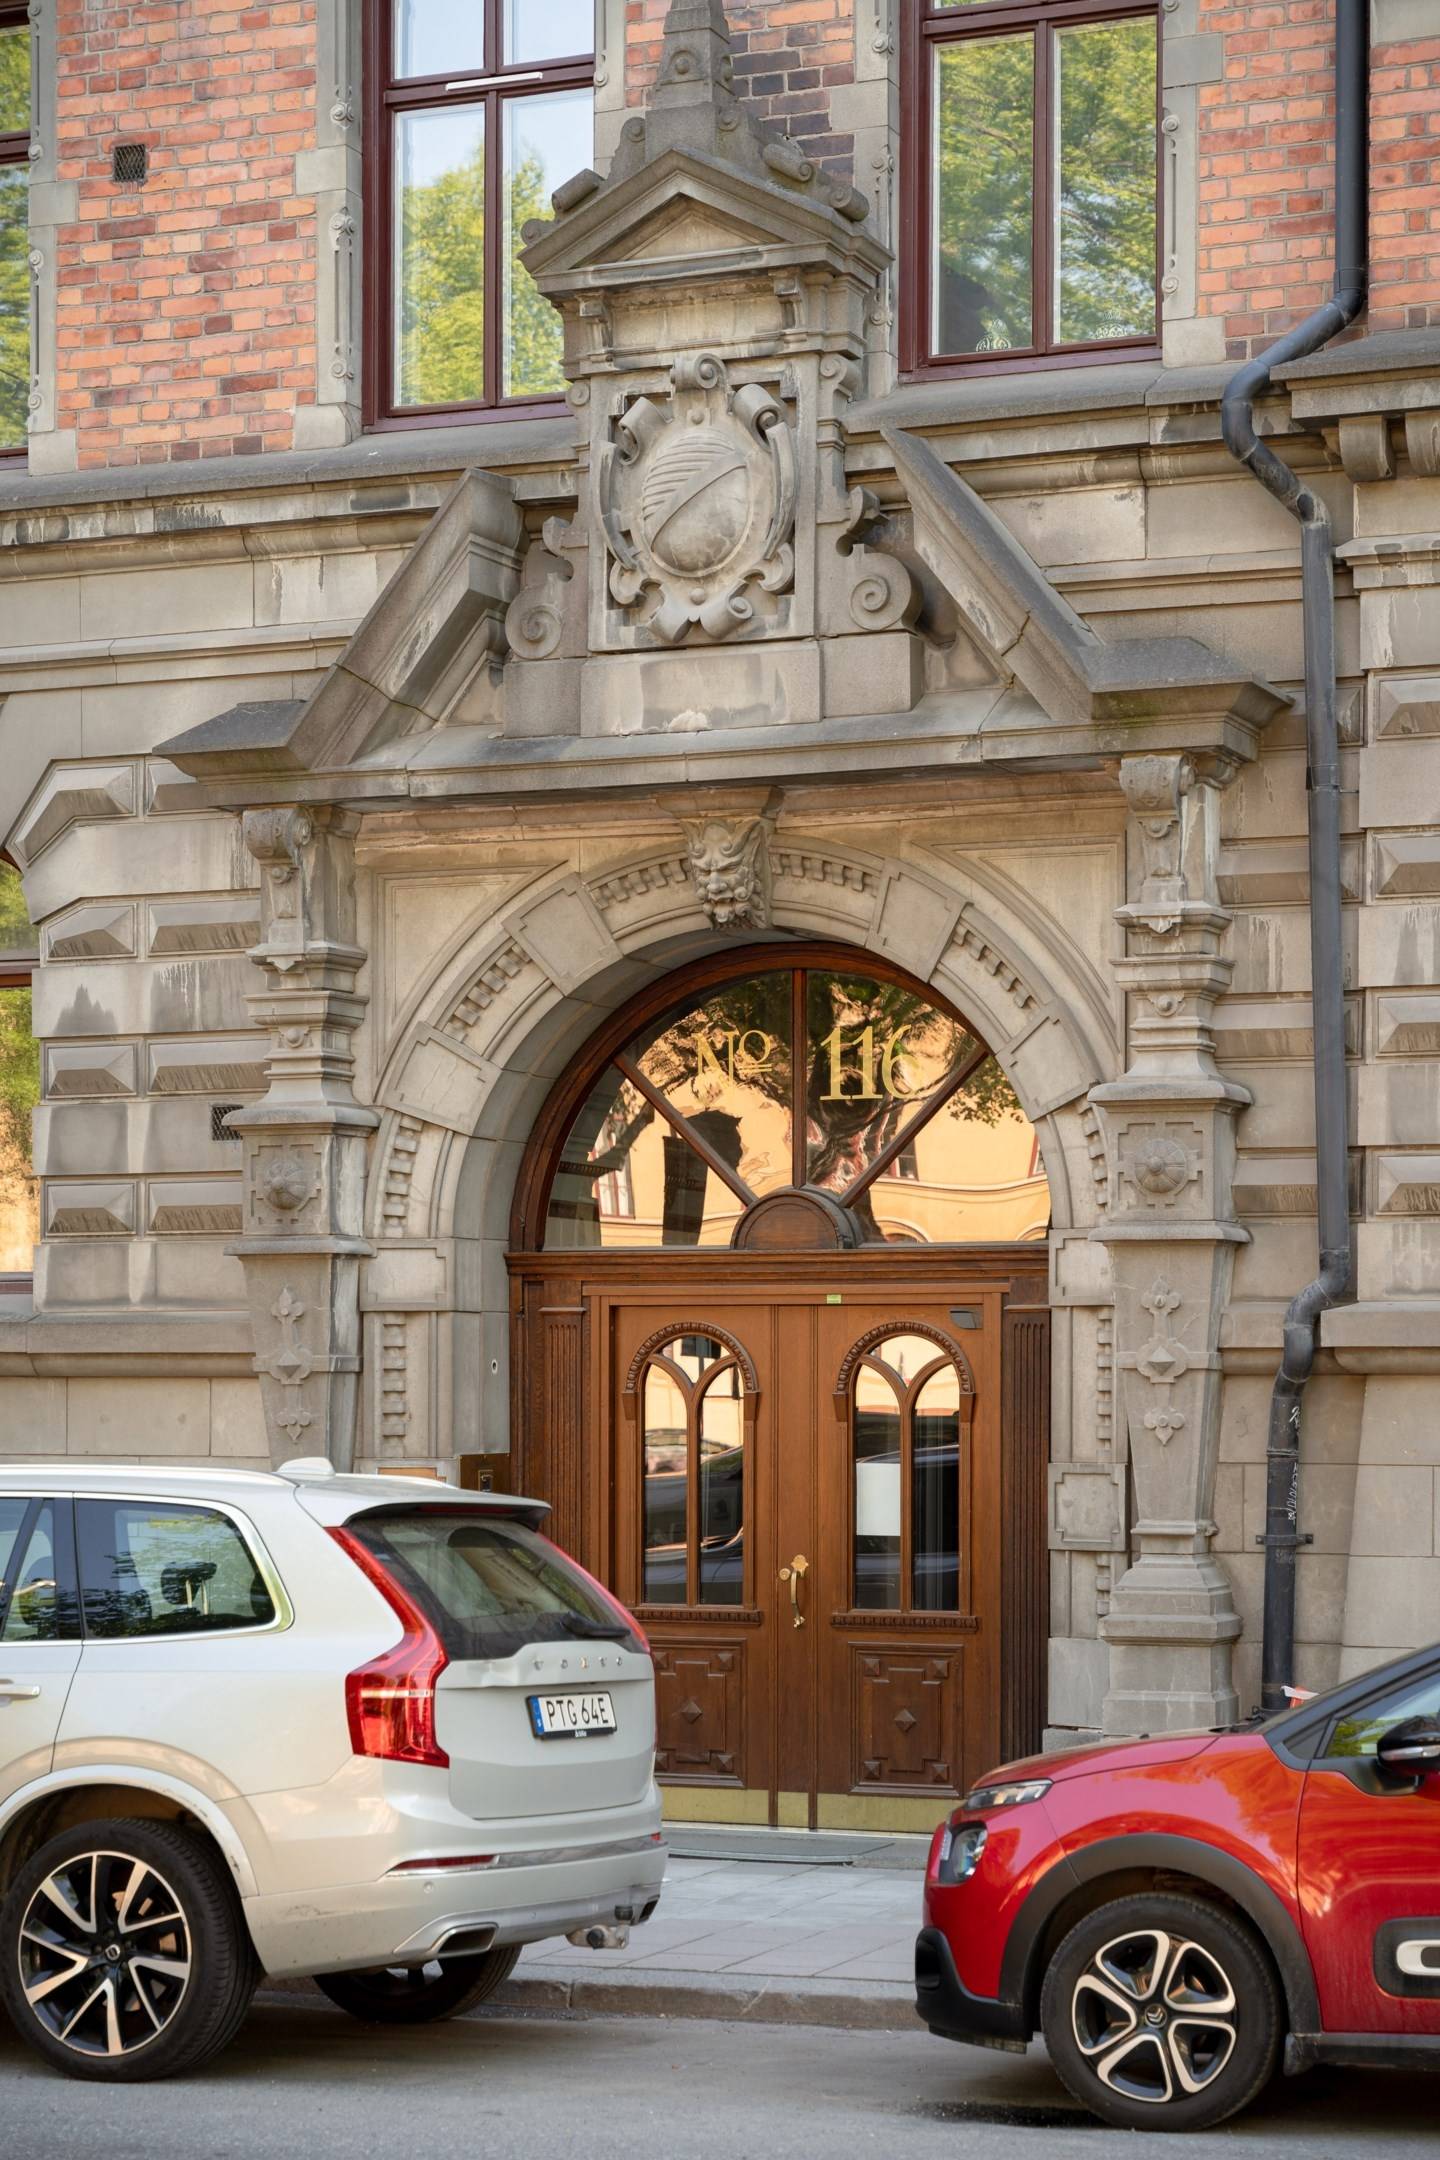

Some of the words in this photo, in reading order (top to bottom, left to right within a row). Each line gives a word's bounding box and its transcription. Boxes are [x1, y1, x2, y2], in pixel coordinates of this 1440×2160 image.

[820, 1024, 921, 1101] 116
[546, 1699, 578, 1728] PTG
[581, 1697, 609, 1725] 64E
